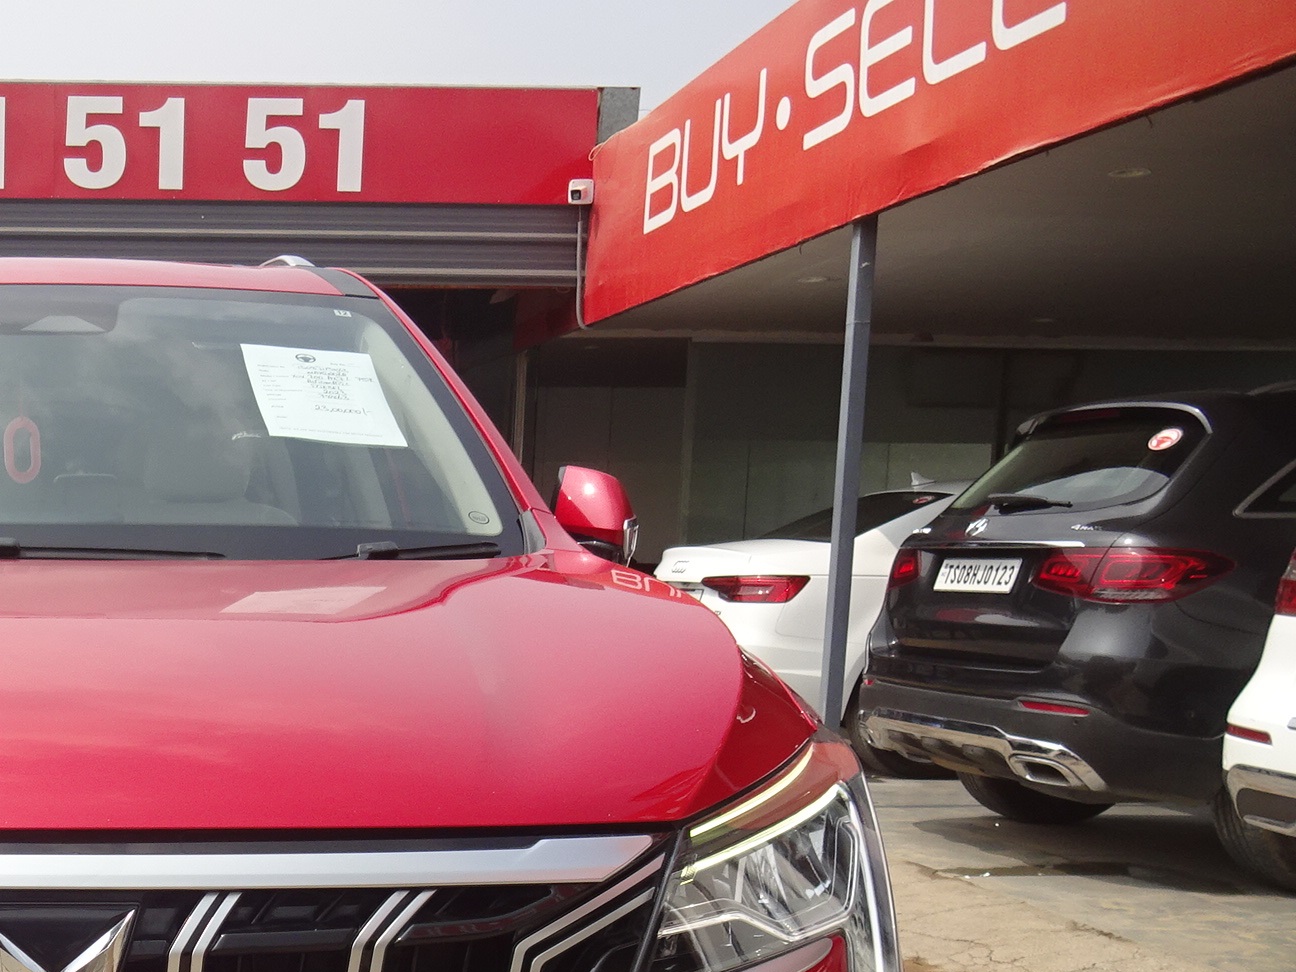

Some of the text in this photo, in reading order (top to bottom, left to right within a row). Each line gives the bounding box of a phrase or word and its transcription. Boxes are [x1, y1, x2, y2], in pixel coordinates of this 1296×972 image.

[63, 95, 186, 190] 51
[242, 98, 365, 192] 51
[643, 69, 768, 235] BUY
[944, 562, 1015, 586] TS08HJ0123
